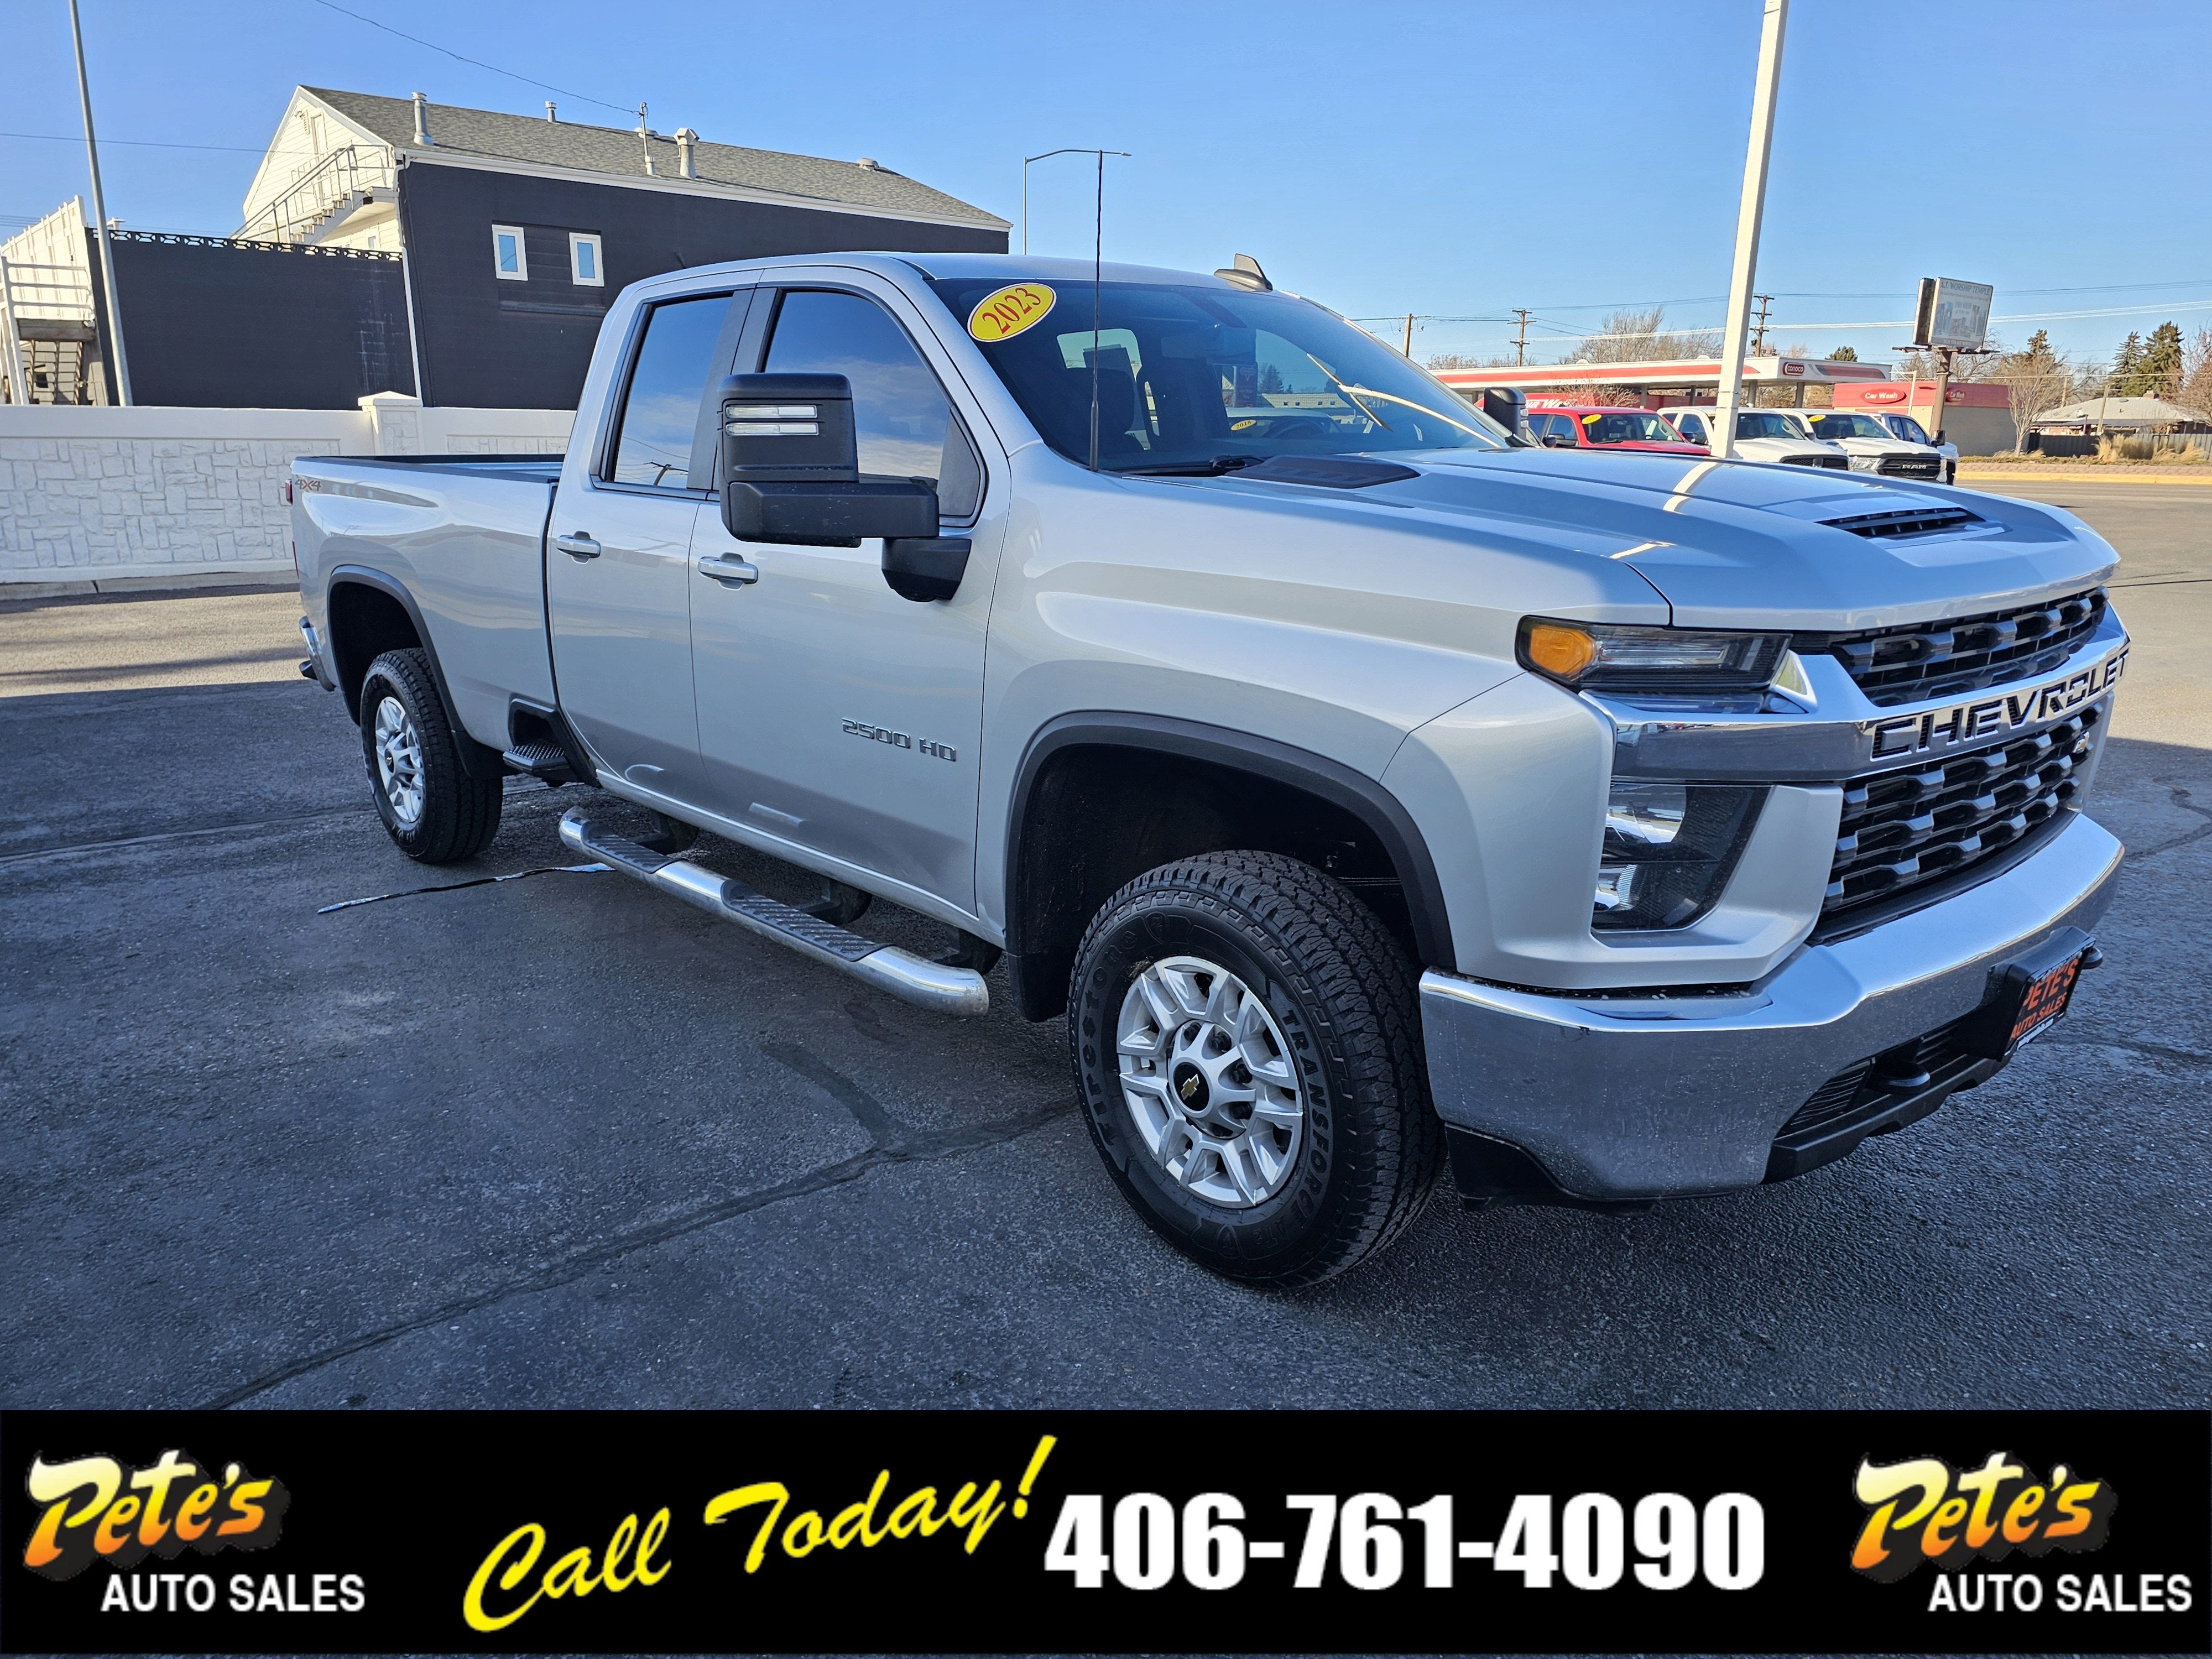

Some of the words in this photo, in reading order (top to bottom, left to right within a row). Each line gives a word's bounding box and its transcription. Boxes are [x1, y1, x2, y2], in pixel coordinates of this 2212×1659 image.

[1950, 282, 1972, 293] WORSHIP
[1973, 285, 1990, 295] TEMPLE
[982, 287, 1041, 335] 2023
[1236, 420, 1252, 429] 2018
[1870, 648, 2131, 761] CHEVROLET
[842, 717, 911, 749] 2500
[919, 737, 957, 762] HD
[2037, 992, 2068, 1022] SALES
